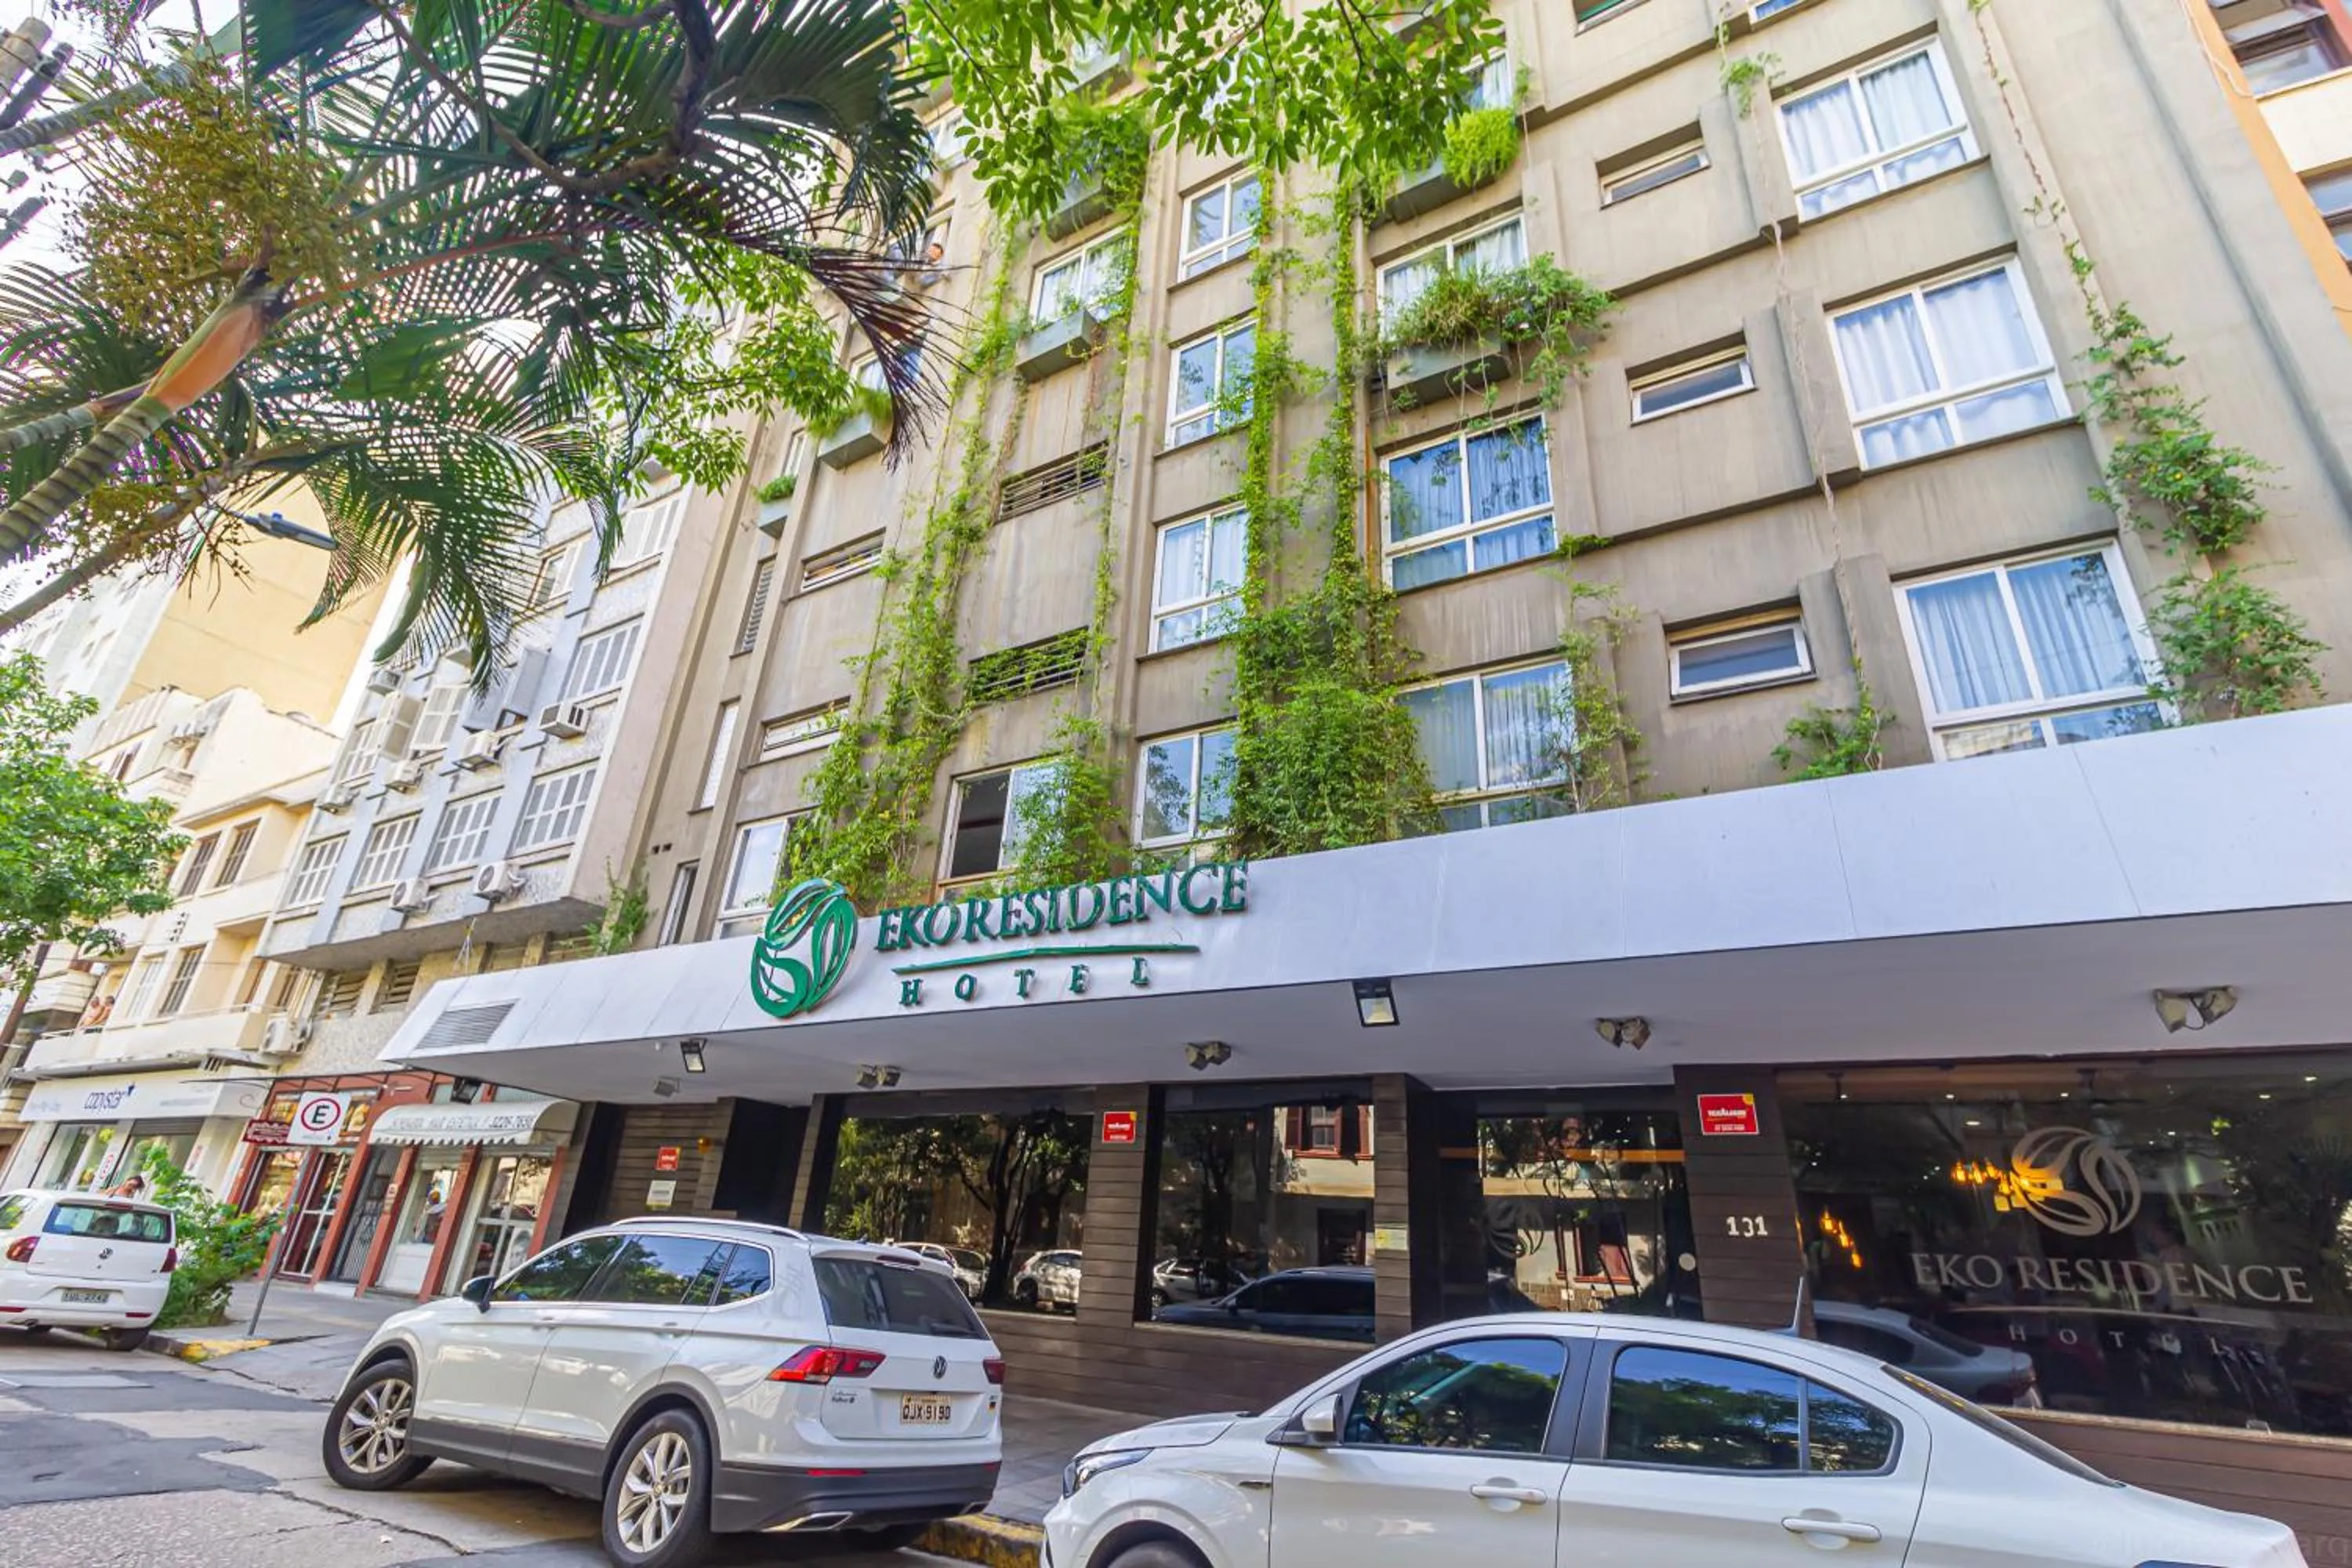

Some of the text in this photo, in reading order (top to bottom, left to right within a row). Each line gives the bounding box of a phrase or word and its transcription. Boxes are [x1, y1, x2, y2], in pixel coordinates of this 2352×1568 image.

[875, 856, 1247, 950] EKORESIDENCE
[899, 956, 1149, 1006] HOTEL
[311, 1104, 330, 1123] E
[1726, 1215, 1768, 1237] 131
[1911, 1254, 2313, 1303] EKO RESIDENCE
